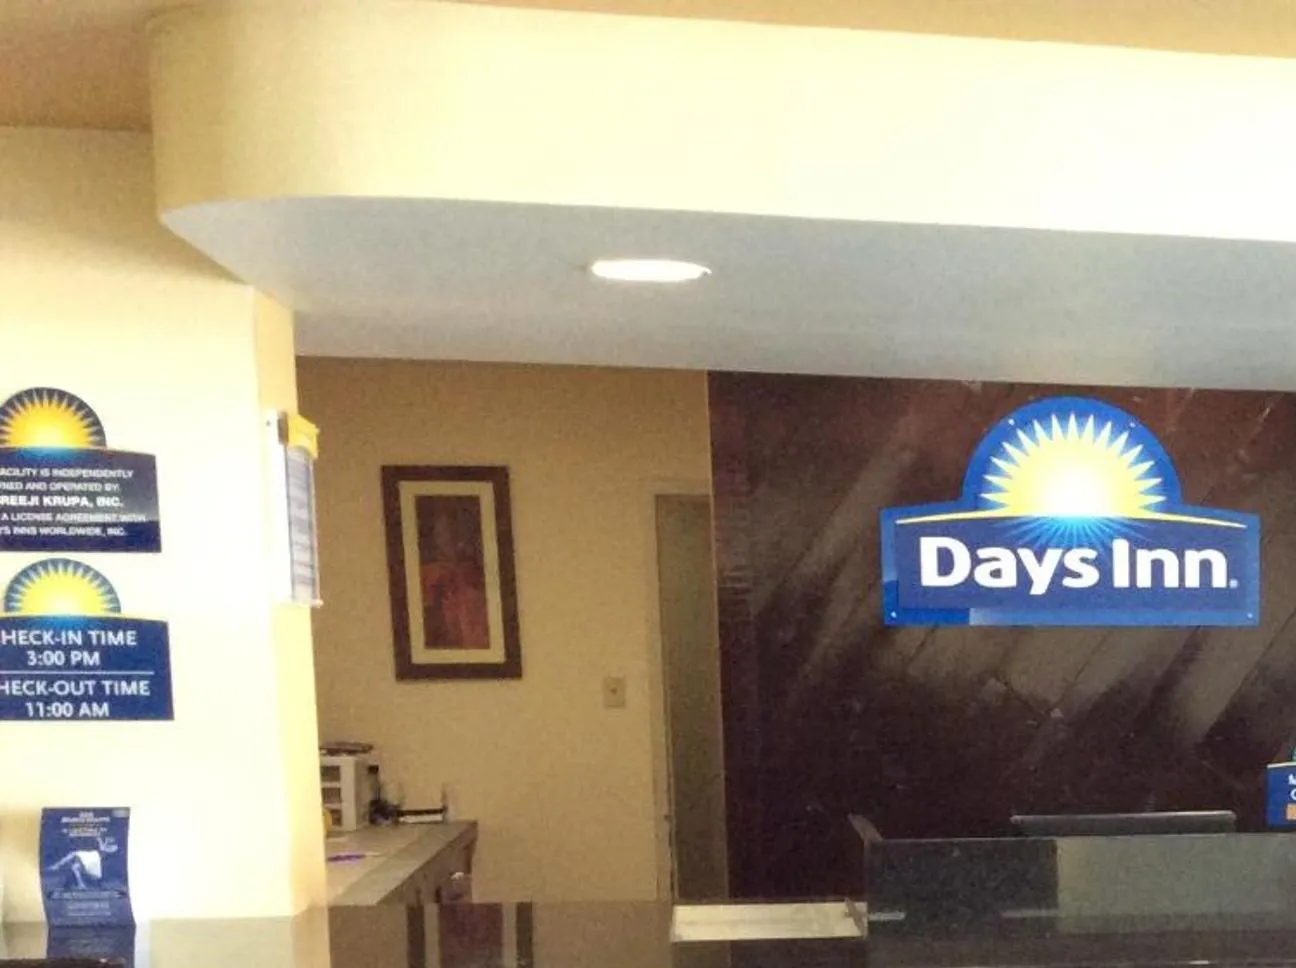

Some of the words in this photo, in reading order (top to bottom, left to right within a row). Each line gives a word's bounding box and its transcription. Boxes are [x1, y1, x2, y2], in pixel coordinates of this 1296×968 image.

[40, 468, 50, 477] IS
[52, 468, 134, 479] INDEPENDENTLY
[25, 482, 48, 492] AND
[50, 482, 102, 492] OPERATED
[96, 496, 124, 508] INC.
[11, 512, 53, 522] LICENSE
[55, 512, 118, 523] AGREEMENT
[919, 535, 1100, 596] Days
[88, 630, 137, 646] TIME
[27, 650, 65, 666] 3:00
[70, 650, 101, 667] PM
[101, 679, 151, 697] TIME
[25, 702, 73, 718] 11:00
[78, 702, 110, 718] AM
